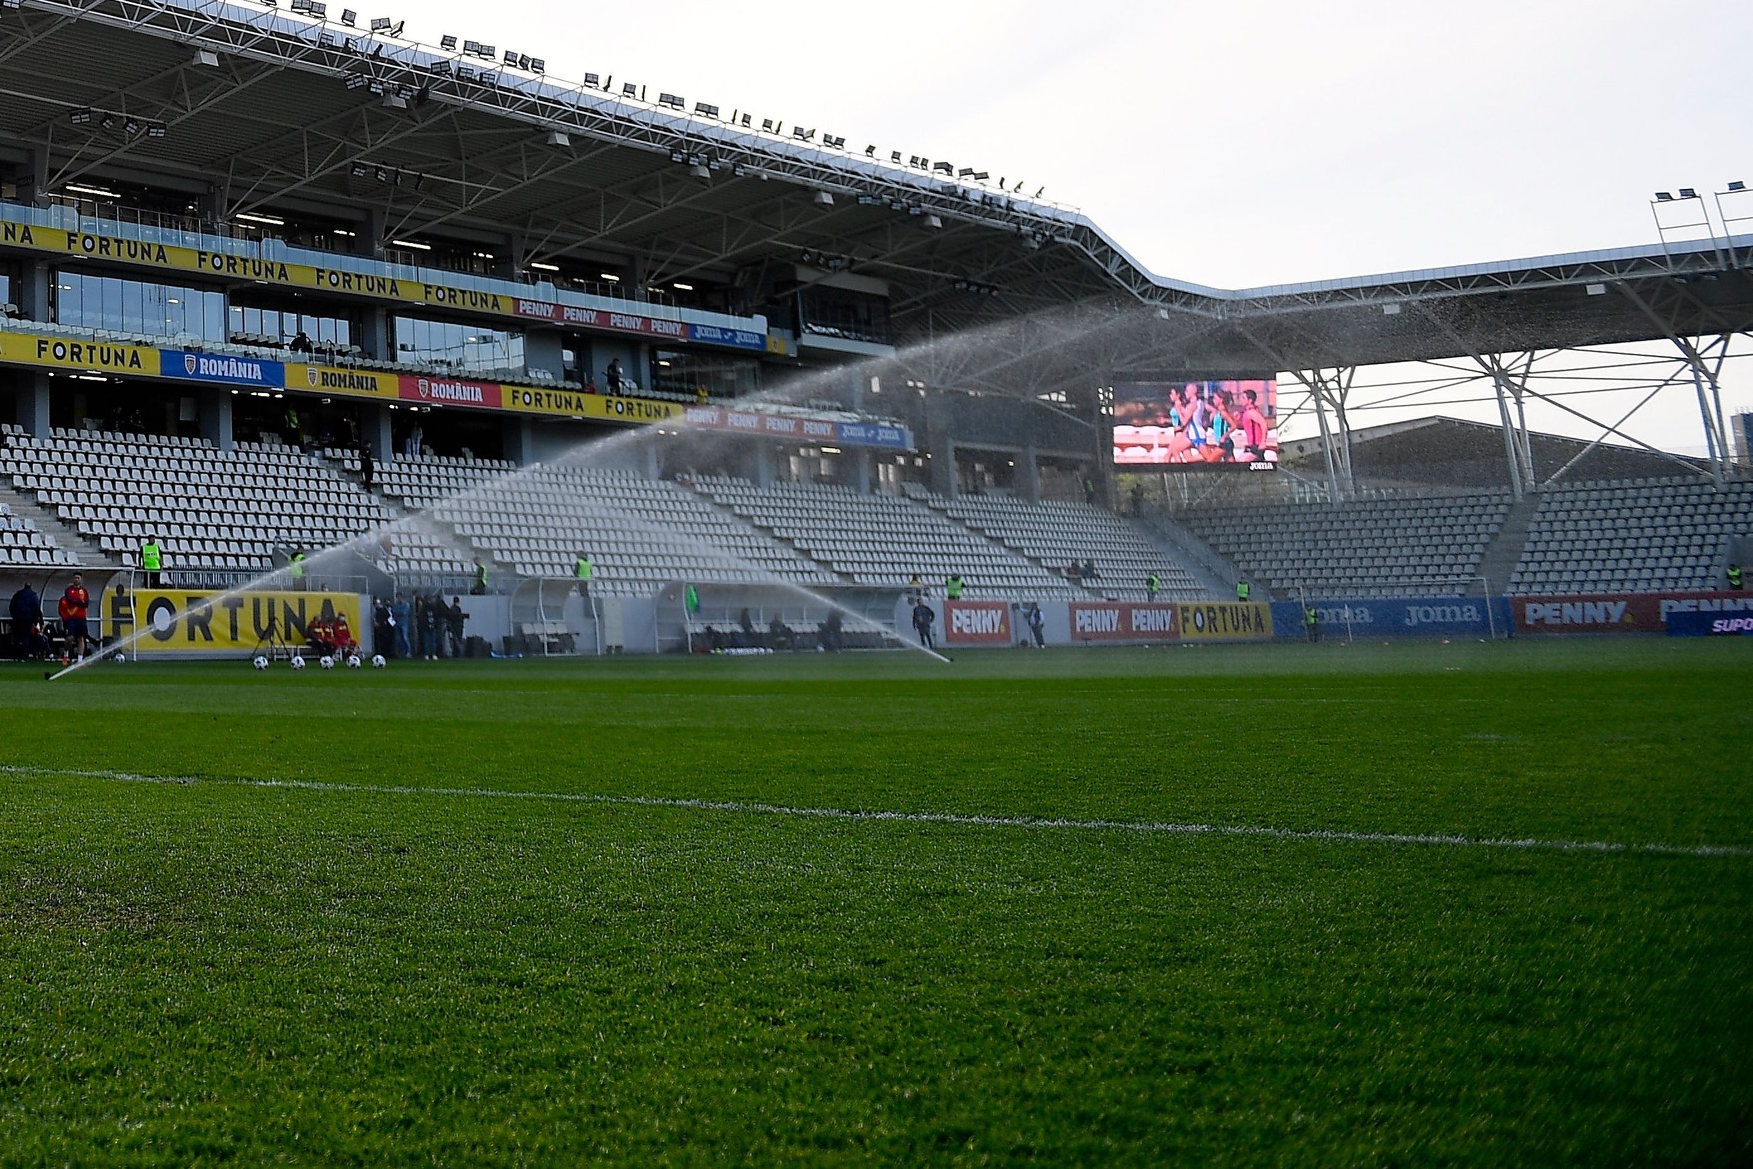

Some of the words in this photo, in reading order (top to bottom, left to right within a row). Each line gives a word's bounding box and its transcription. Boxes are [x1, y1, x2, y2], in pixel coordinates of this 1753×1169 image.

[67, 232, 168, 263] FORTUNA
[198, 251, 289, 281] FORTUNA
[316, 269, 400, 296] FORTUNA
[424, 284, 500, 311] FORTUNA
[37, 339, 141, 369] FORTUNA
[199, 357, 262, 380] ROMÂNIA
[321, 371, 377, 391] ROMÂNIA
[431, 382, 483, 402] ROMÂNIA
[512, 391, 584, 411] FORTUNA
[606, 399, 672, 419] FORTUNA
[111, 595, 339, 642] FORTUNA
[1180, 604, 1264, 633] FORTUNA
[1316, 606, 1373, 624] oma
